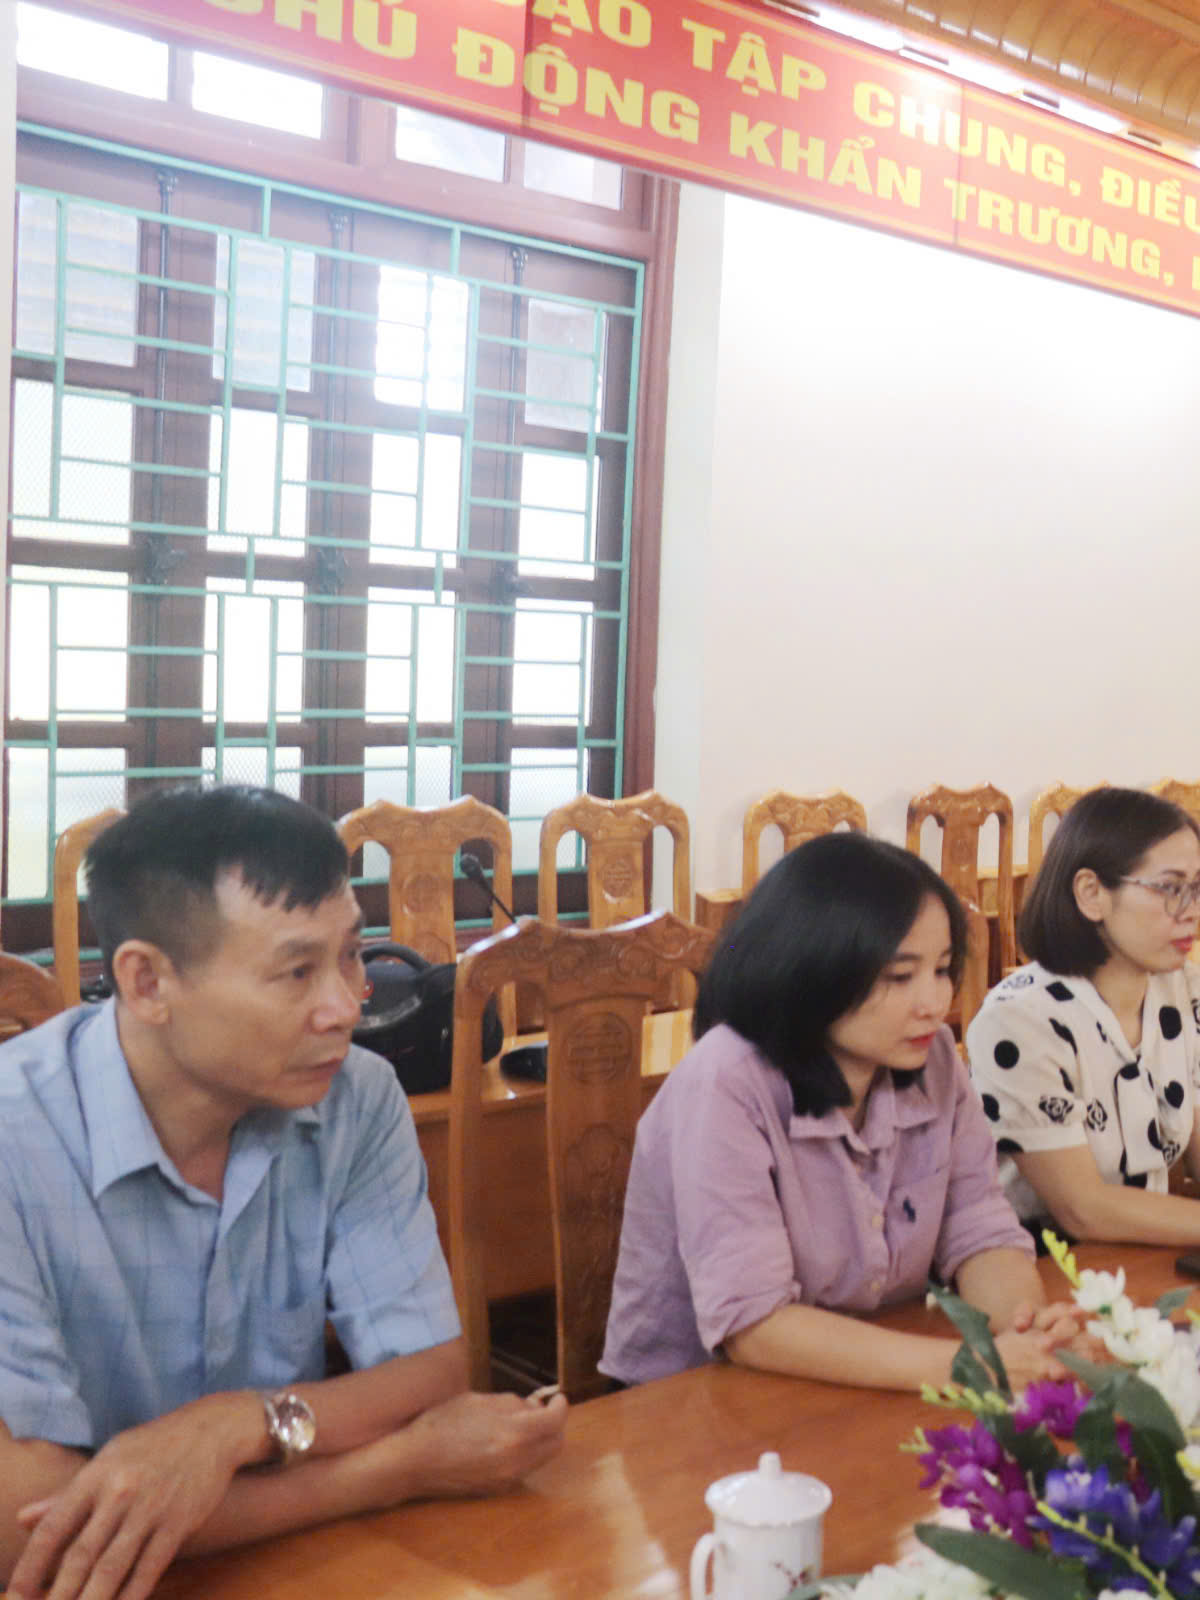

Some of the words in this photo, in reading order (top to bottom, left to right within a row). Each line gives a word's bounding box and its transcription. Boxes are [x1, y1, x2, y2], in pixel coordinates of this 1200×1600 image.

[452, 27, 700, 144] ĐỘNG
[729, 111, 922, 208] KHẨN
[943, 176, 1175, 286] TRƯƠNG,
[492, 0, 652, 47] ẠO
[682, 17, 827, 101] TẬP
[853, 81, 1082, 196] CHUNG,
